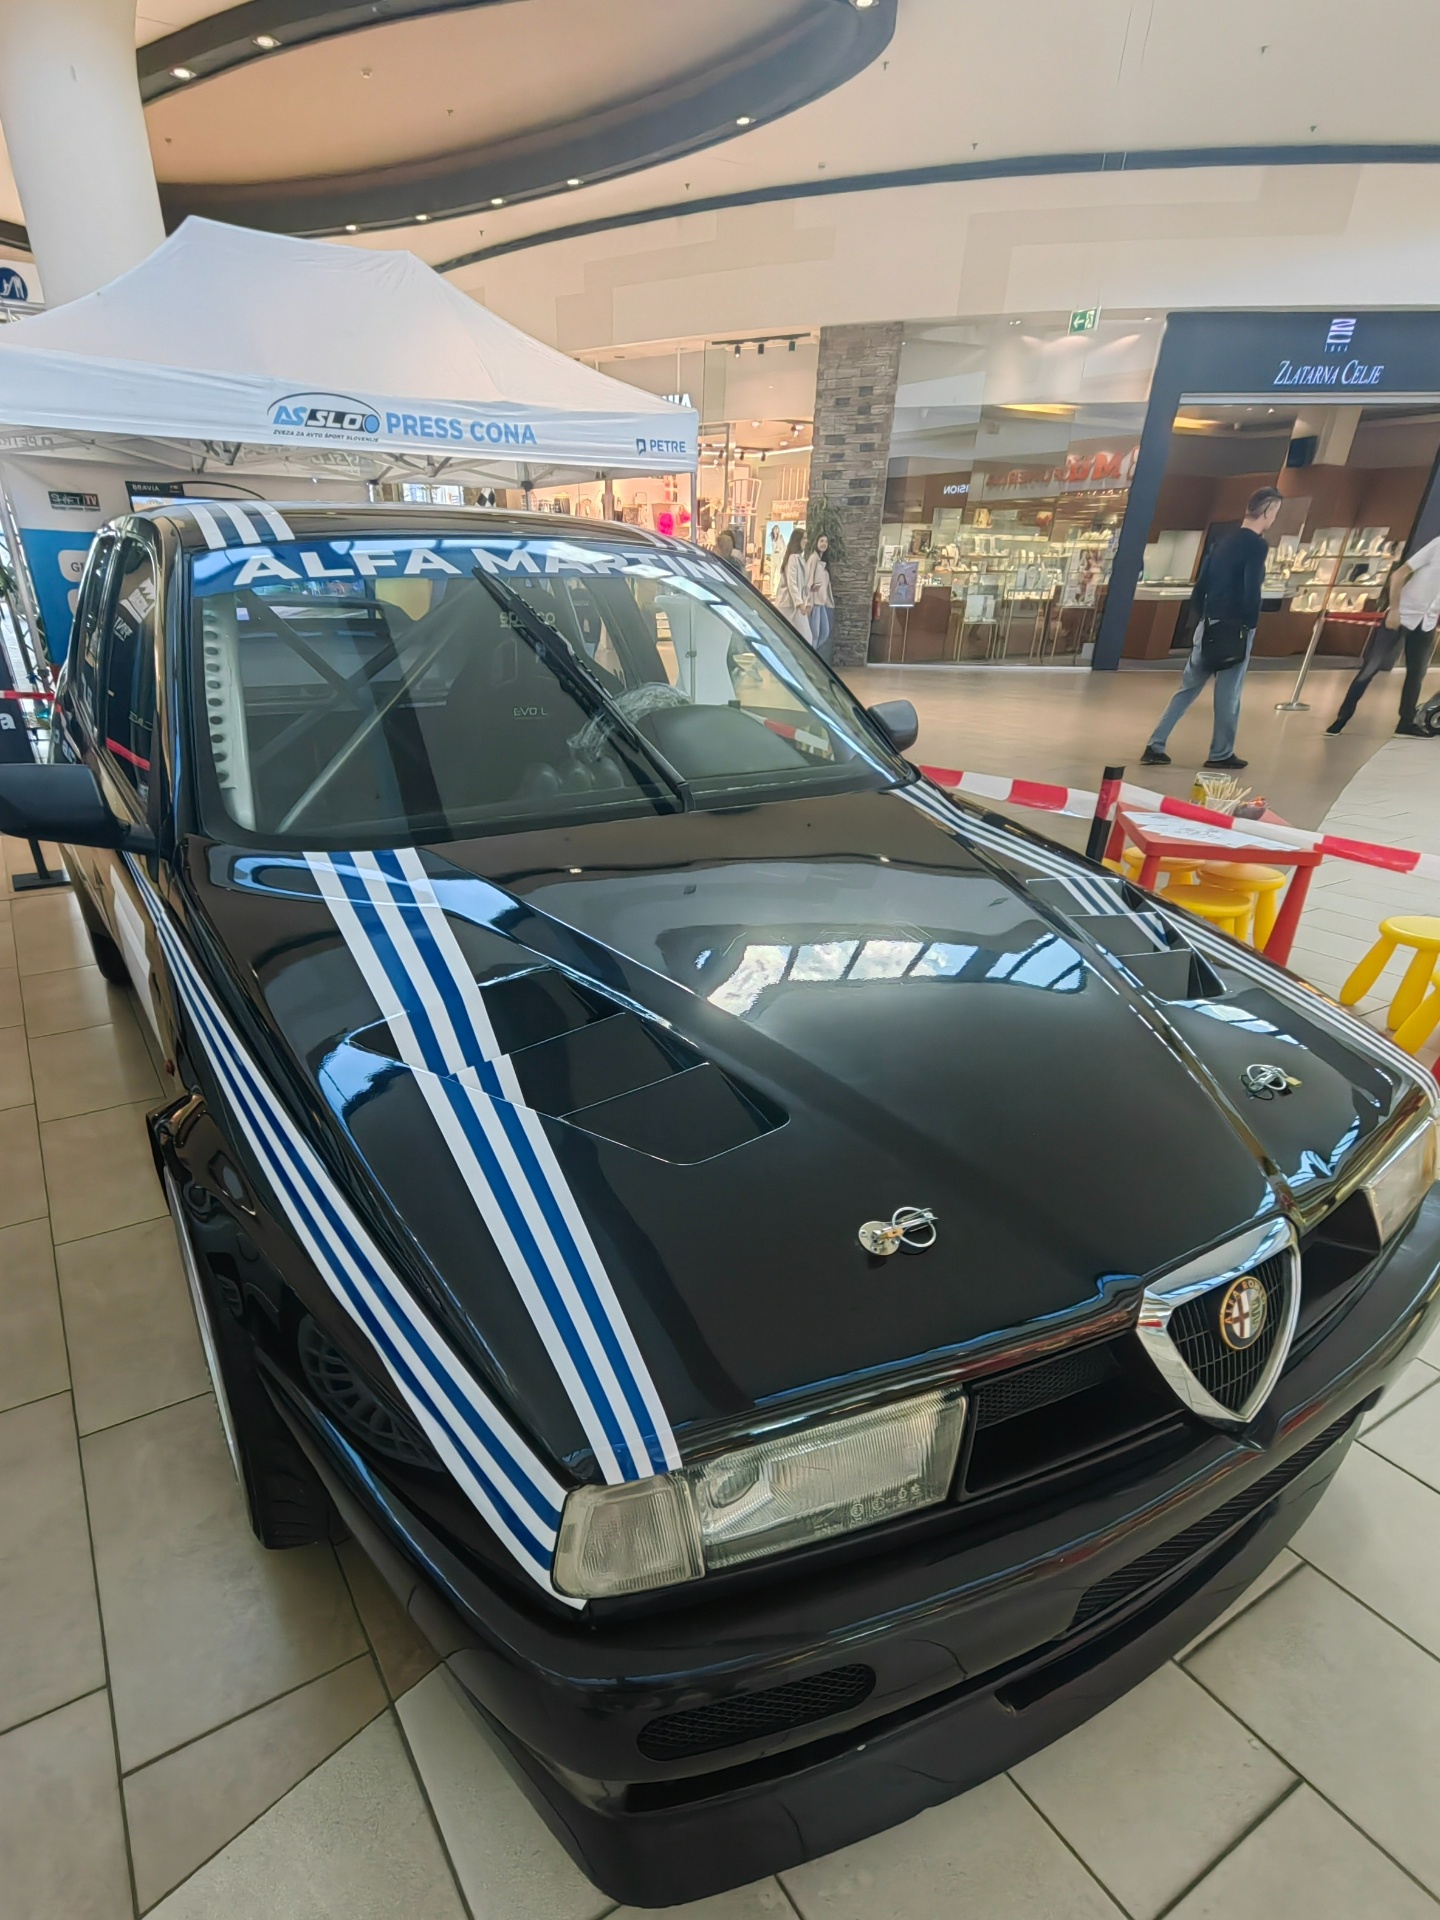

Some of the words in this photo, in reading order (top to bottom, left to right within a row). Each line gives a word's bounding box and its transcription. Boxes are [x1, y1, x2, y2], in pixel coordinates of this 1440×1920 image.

[386, 412, 463, 440] PRESS
[470, 420, 537, 445] CONA
[324, 432, 345, 440] ŠPORT
[346, 435, 380, 443] SLOVENIJE
[649, 439, 687, 453] PETRE
[132, 483, 160, 493] BRAVIA
[233, 548, 463, 586] ALFA
[470, 548, 738, 587] MARTINI
